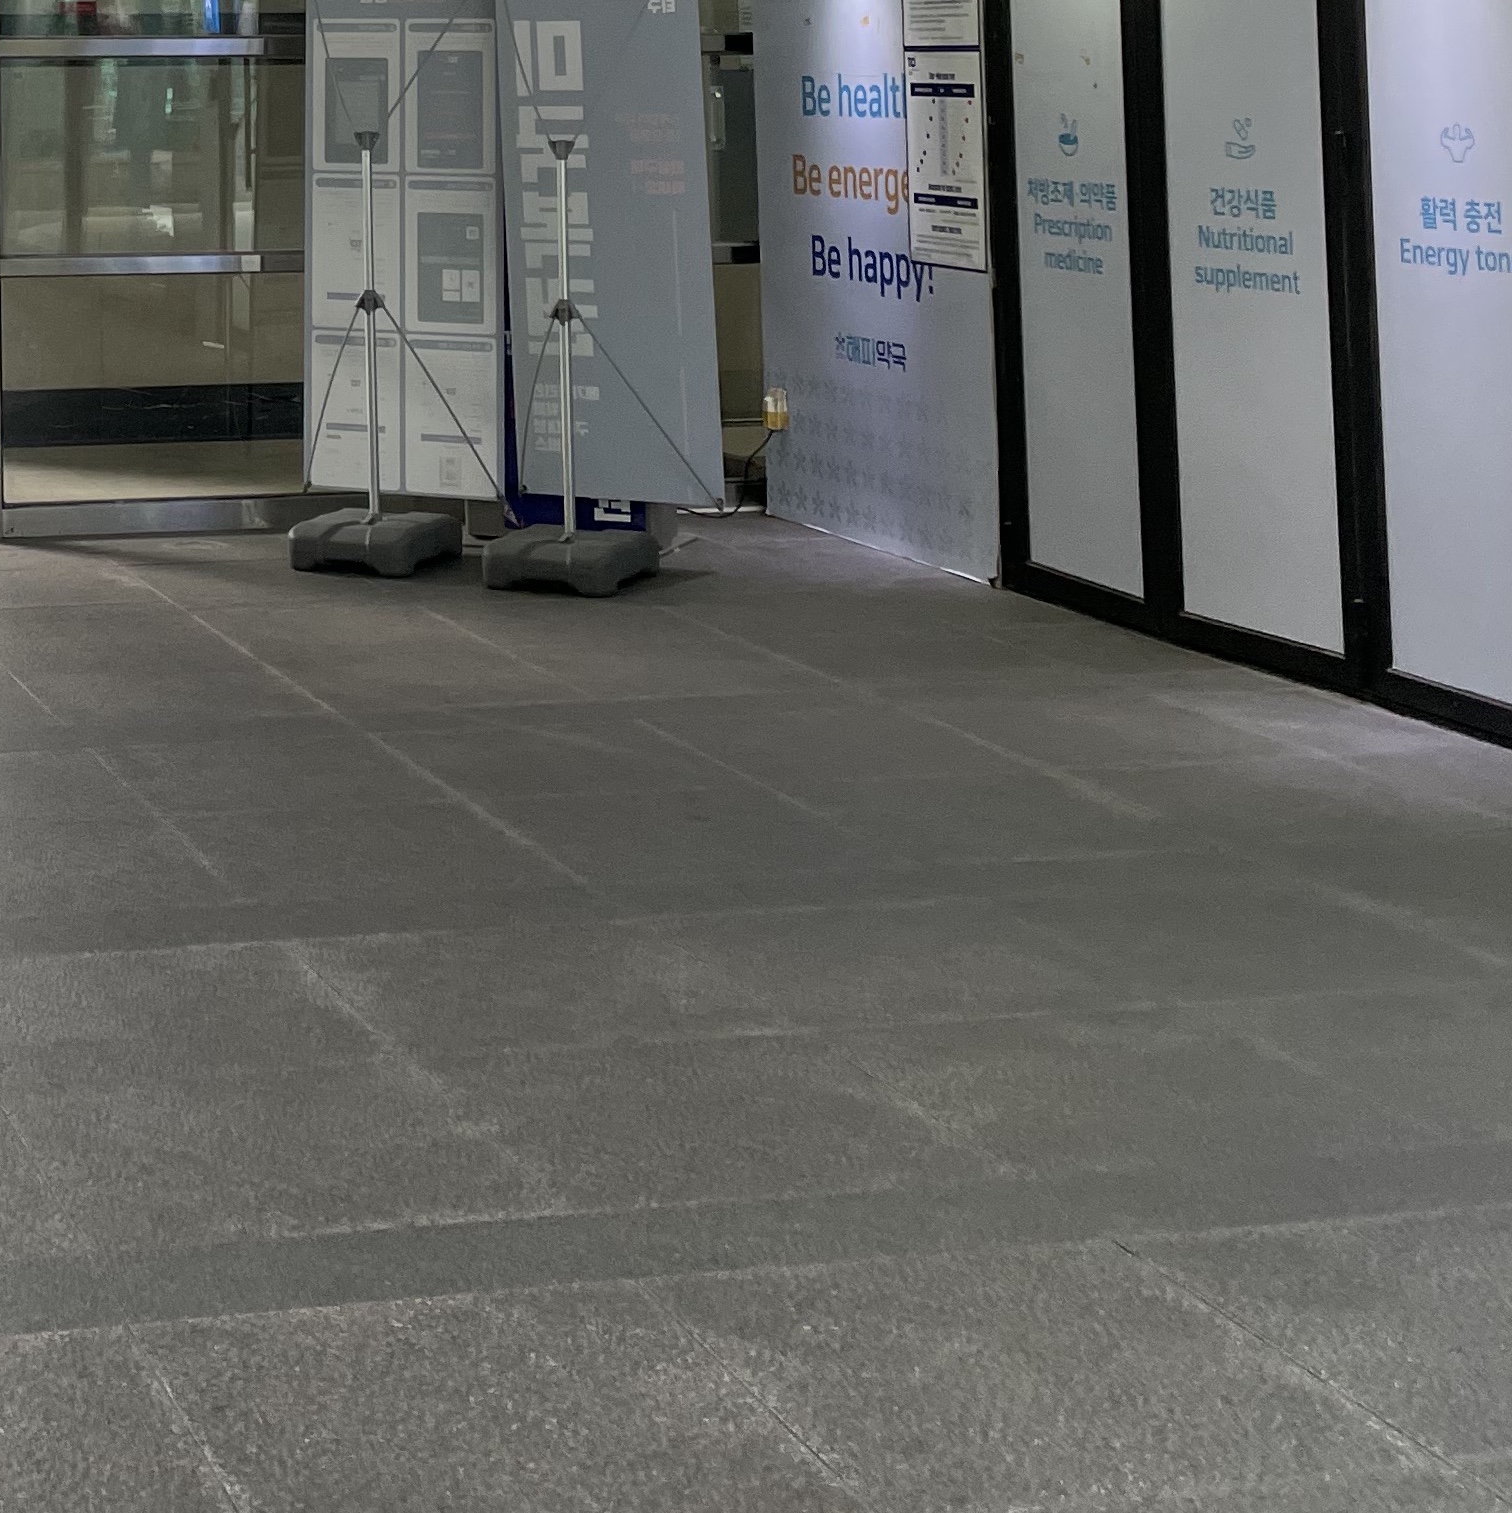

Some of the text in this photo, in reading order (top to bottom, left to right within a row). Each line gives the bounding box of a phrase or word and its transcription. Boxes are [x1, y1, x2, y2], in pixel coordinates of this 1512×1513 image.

[801, 74, 831, 118] Be
[792, 153, 822, 197] Be
[1079, 181, 1118, 212] 의약품
[1209, 186, 1278, 221] 건강식품
[1034, 212, 1113, 245] Prescription
[1419, 195, 1502, 235] 활력 충전
[811, 234, 841, 279] Be
[1198, 224, 1294, 257] Nutritional
[1400, 237, 1469, 276] Energy
[1044, 248, 1105, 276] medicine
[1194, 263, 1302, 296] supplement
